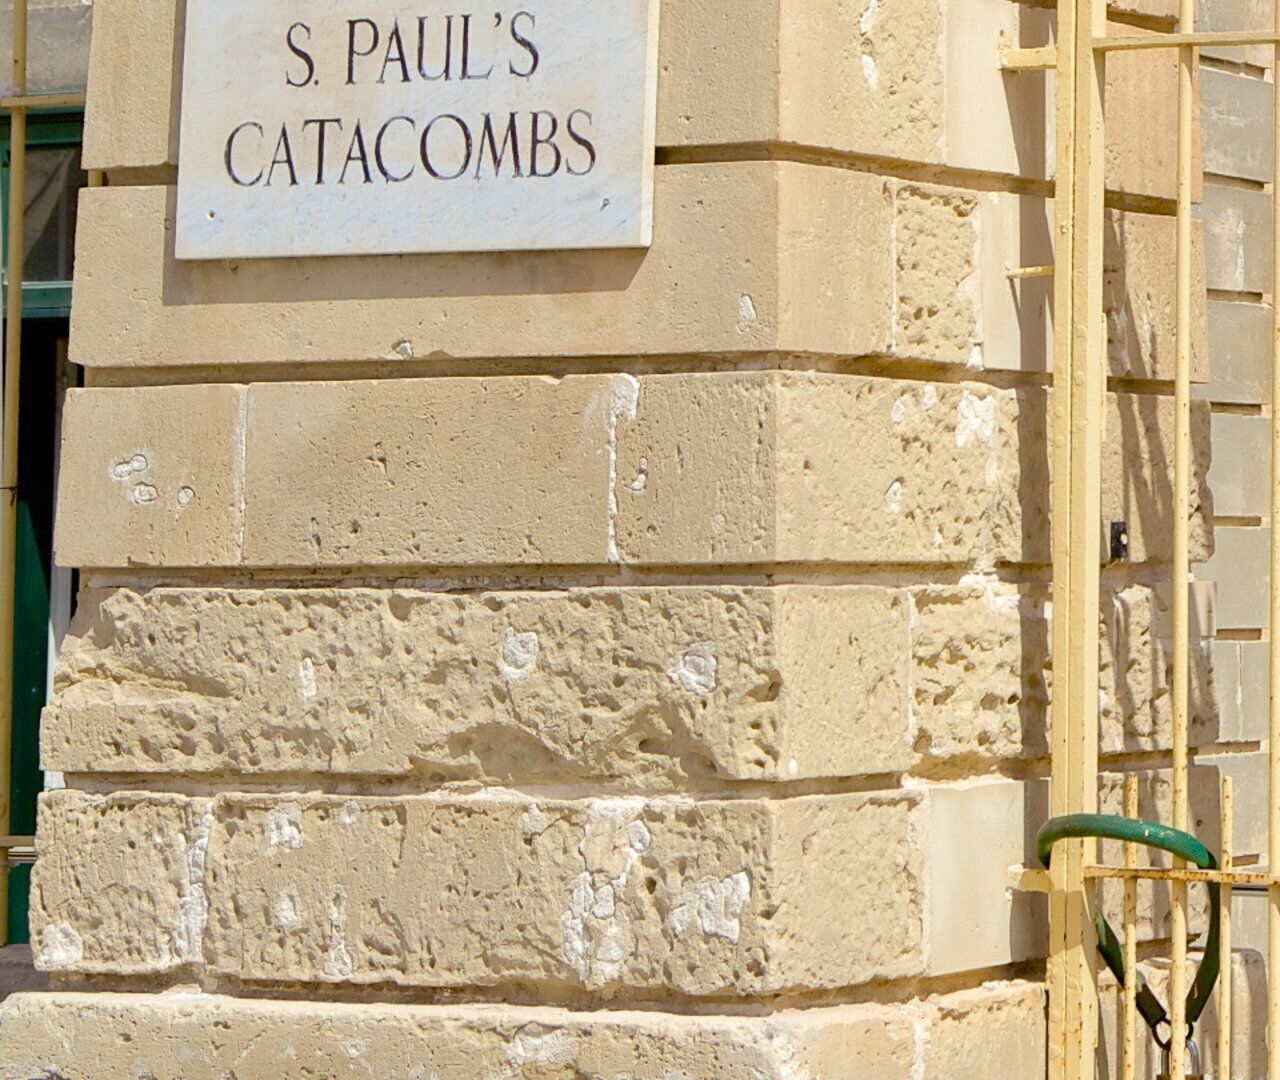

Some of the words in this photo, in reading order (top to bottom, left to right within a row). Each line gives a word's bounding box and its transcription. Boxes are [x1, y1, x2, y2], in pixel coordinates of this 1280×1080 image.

[285, 20, 320, 89] S.
[345, 10, 540, 87] PAUL'S
[223, 108, 598, 188] CATACOMBS
